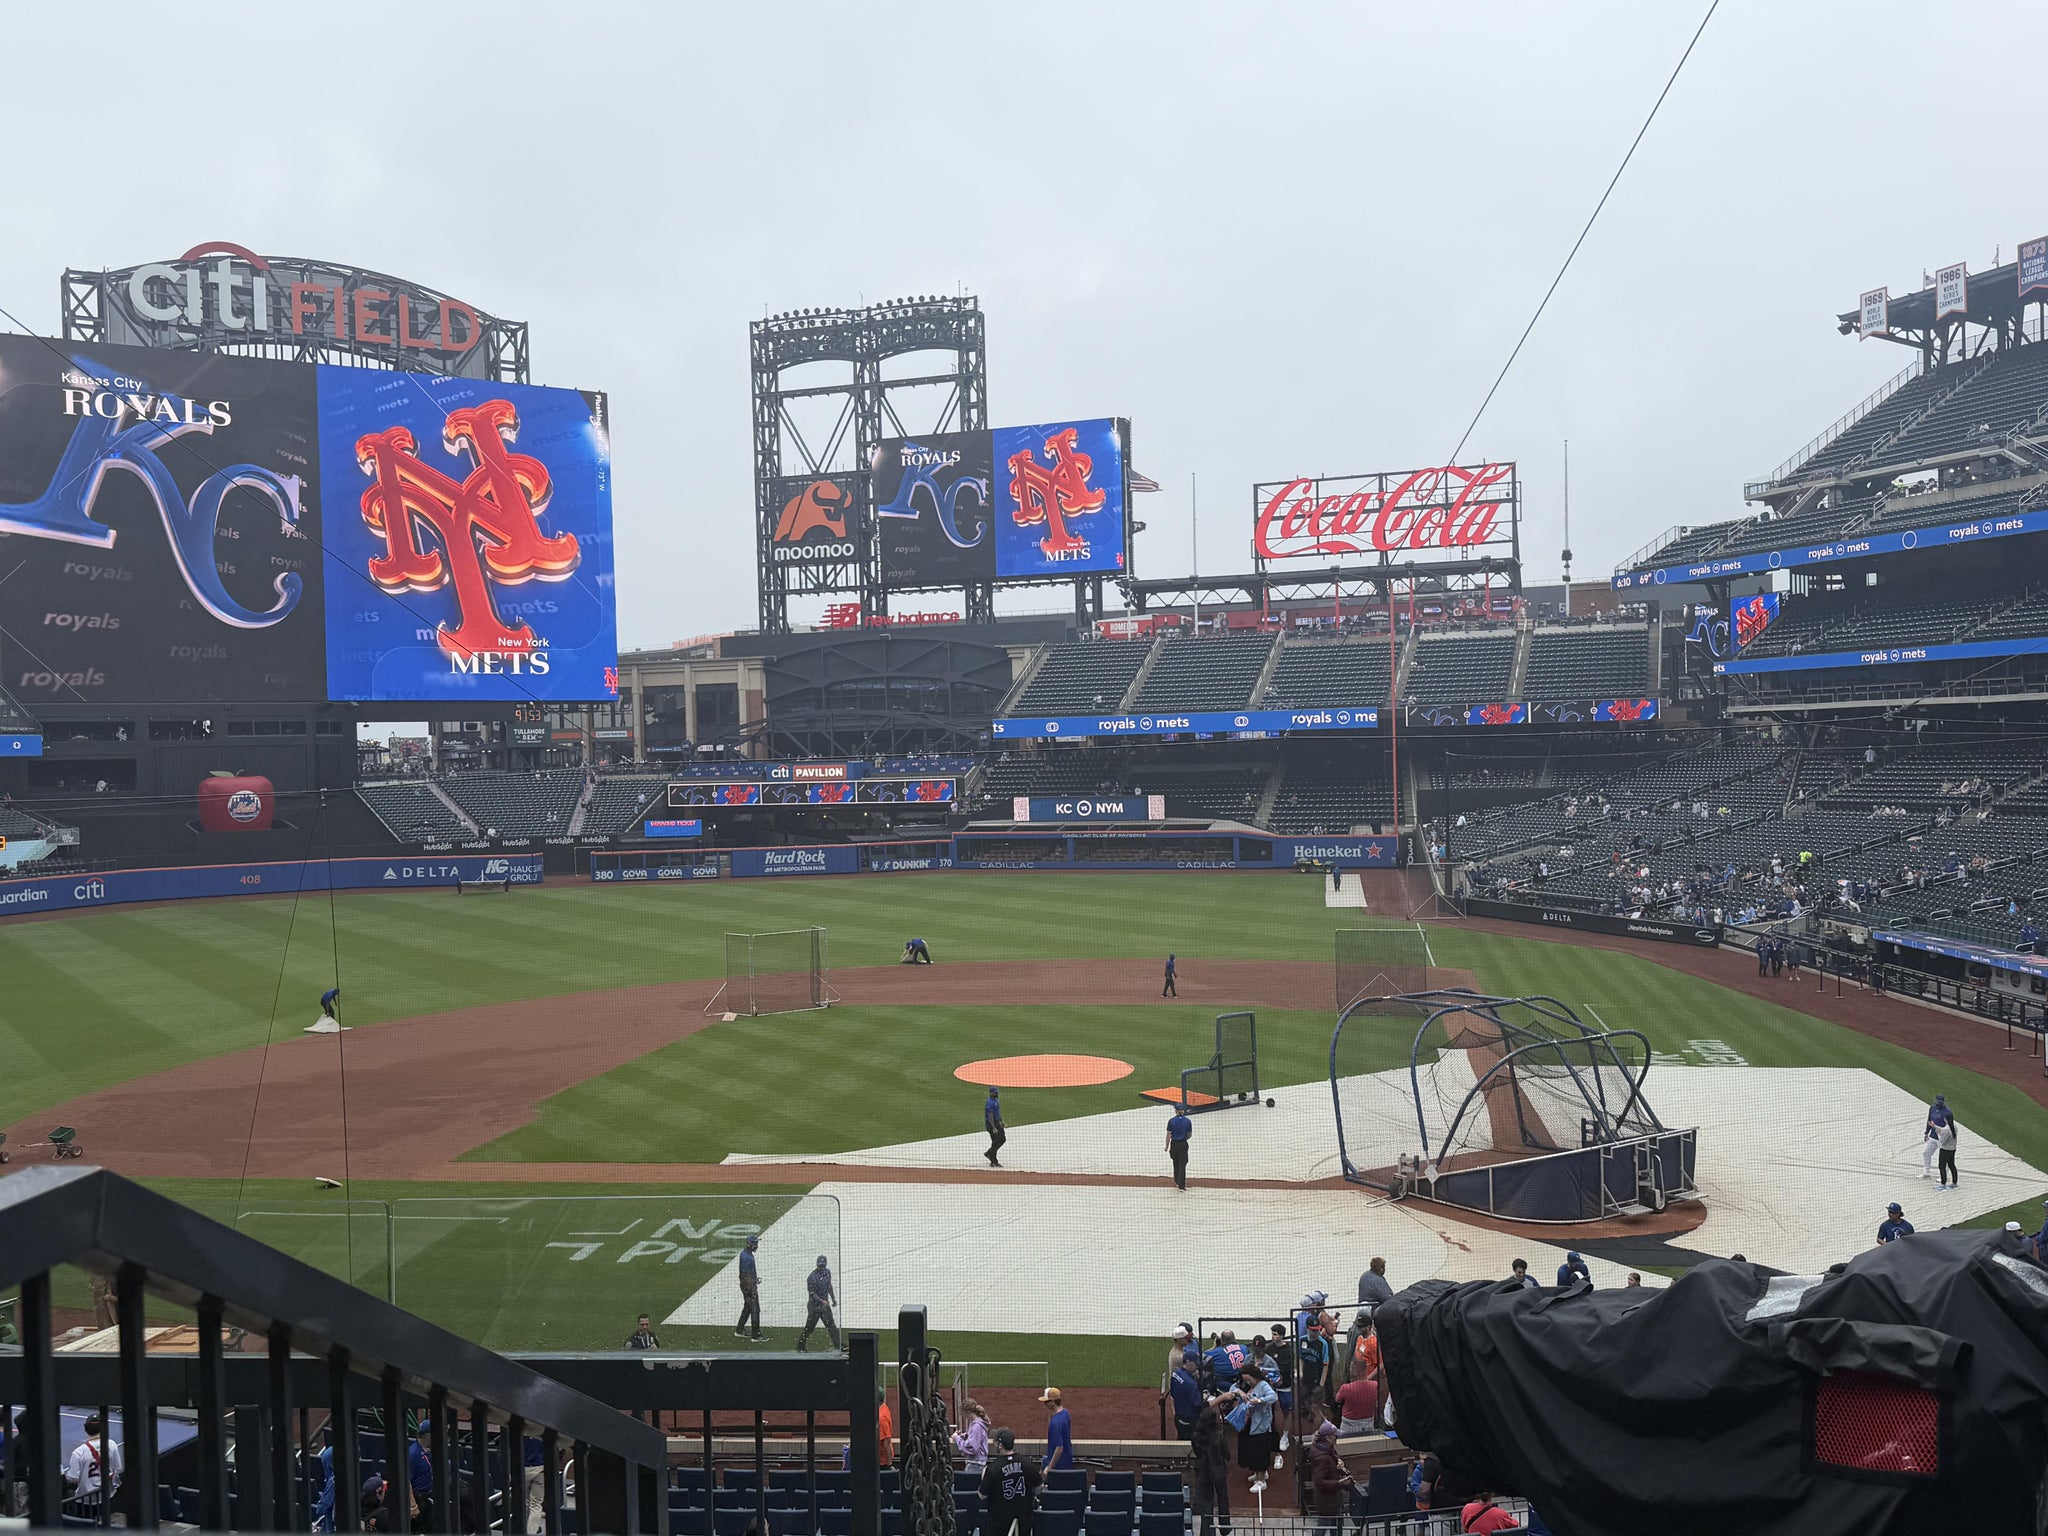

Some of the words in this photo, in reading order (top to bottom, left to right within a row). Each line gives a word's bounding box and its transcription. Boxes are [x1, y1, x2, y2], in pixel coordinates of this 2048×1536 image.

[2023, 257, 2047, 269] NATIONAL
[2025, 265, 2044, 275] LEAGUE
[1940, 268, 1961, 284] 1986
[1943, 284, 1959, 292] WORLD
[1943, 290, 1959, 300] SERIES
[129, 241, 270, 332] citi
[291, 282, 481, 350] FIELD
[1864, 292, 1883, 307] 1969
[1939, 296, 1964, 309] CHAMPIONS
[1866, 313, 1882, 321] SERIES
[1867, 307, 1881, 316] WORLD
[1862, 319, 1885, 330] CHAMPIONS
[61, 372, 110, 388] Kansas
[114, 377, 143, 392] City
[62, 388, 232, 427] ROYALS
[378, 397, 410, 413] mets
[901, 450, 961, 467] ROYALS
[1255, 463, 1516, 558] Coca-Cola
[1949, 523, 1979, 539] royals
[1995, 519, 2024, 532] mets
[774, 543, 855, 561] moomoo
[1046, 548, 1091, 562] METS
[1808, 547, 1834, 559] royals
[1847, 542, 1870, 553] mets
[1689, 562, 1711, 577] royals
[1722, 561, 1741, 571] mets
[1617, 577, 1631, 588] 6:10
[1639, 573, 1652, 584] 69°
[43, 611, 121, 631] royals
[864, 614, 894, 627] new
[898, 610, 960, 626] balance
[498, 637, 522, 647] New
[525, 637, 550, 648] York
[450, 651, 550, 675] METS
[1861, 651, 1888, 665] royals
[1902, 649, 1926, 660] mets
[1713, 662, 1725, 673] ets
[19, 668, 107, 691] royals
[1099, 716, 1136, 732] royals
[1156, 716, 1190, 729] mets
[1291, 711, 1332, 727] royals
[513, 728, 546, 736] TULLAMORE
[771, 765, 790, 778] citi
[795, 767, 843, 778] PAVILION
[1056, 803, 1072, 814] KC
[1096, 803, 1123, 814] NYM
[764, 851, 796, 864] Hard
[797, 850, 825, 865] Rock
[1294, 845, 1362, 858] Heineken
[892, 859, 931, 870] DUNKIN'
[939, 859, 952, 867] 370
[402, 866, 459, 878] DELTA
[595, 870, 614, 880] 380
[622, 870, 648, 878] GOYA
[658, 869, 683, 877] GOYA
[693, 867, 717, 876] GOYA
[240, 875, 261, 885] 408
[74, 877, 105, 900] citi
[1549, 914, 1572, 923] DELTA
[1229, 1351, 1245, 1370] 12
[1002, 1476, 1026, 1500] 54
